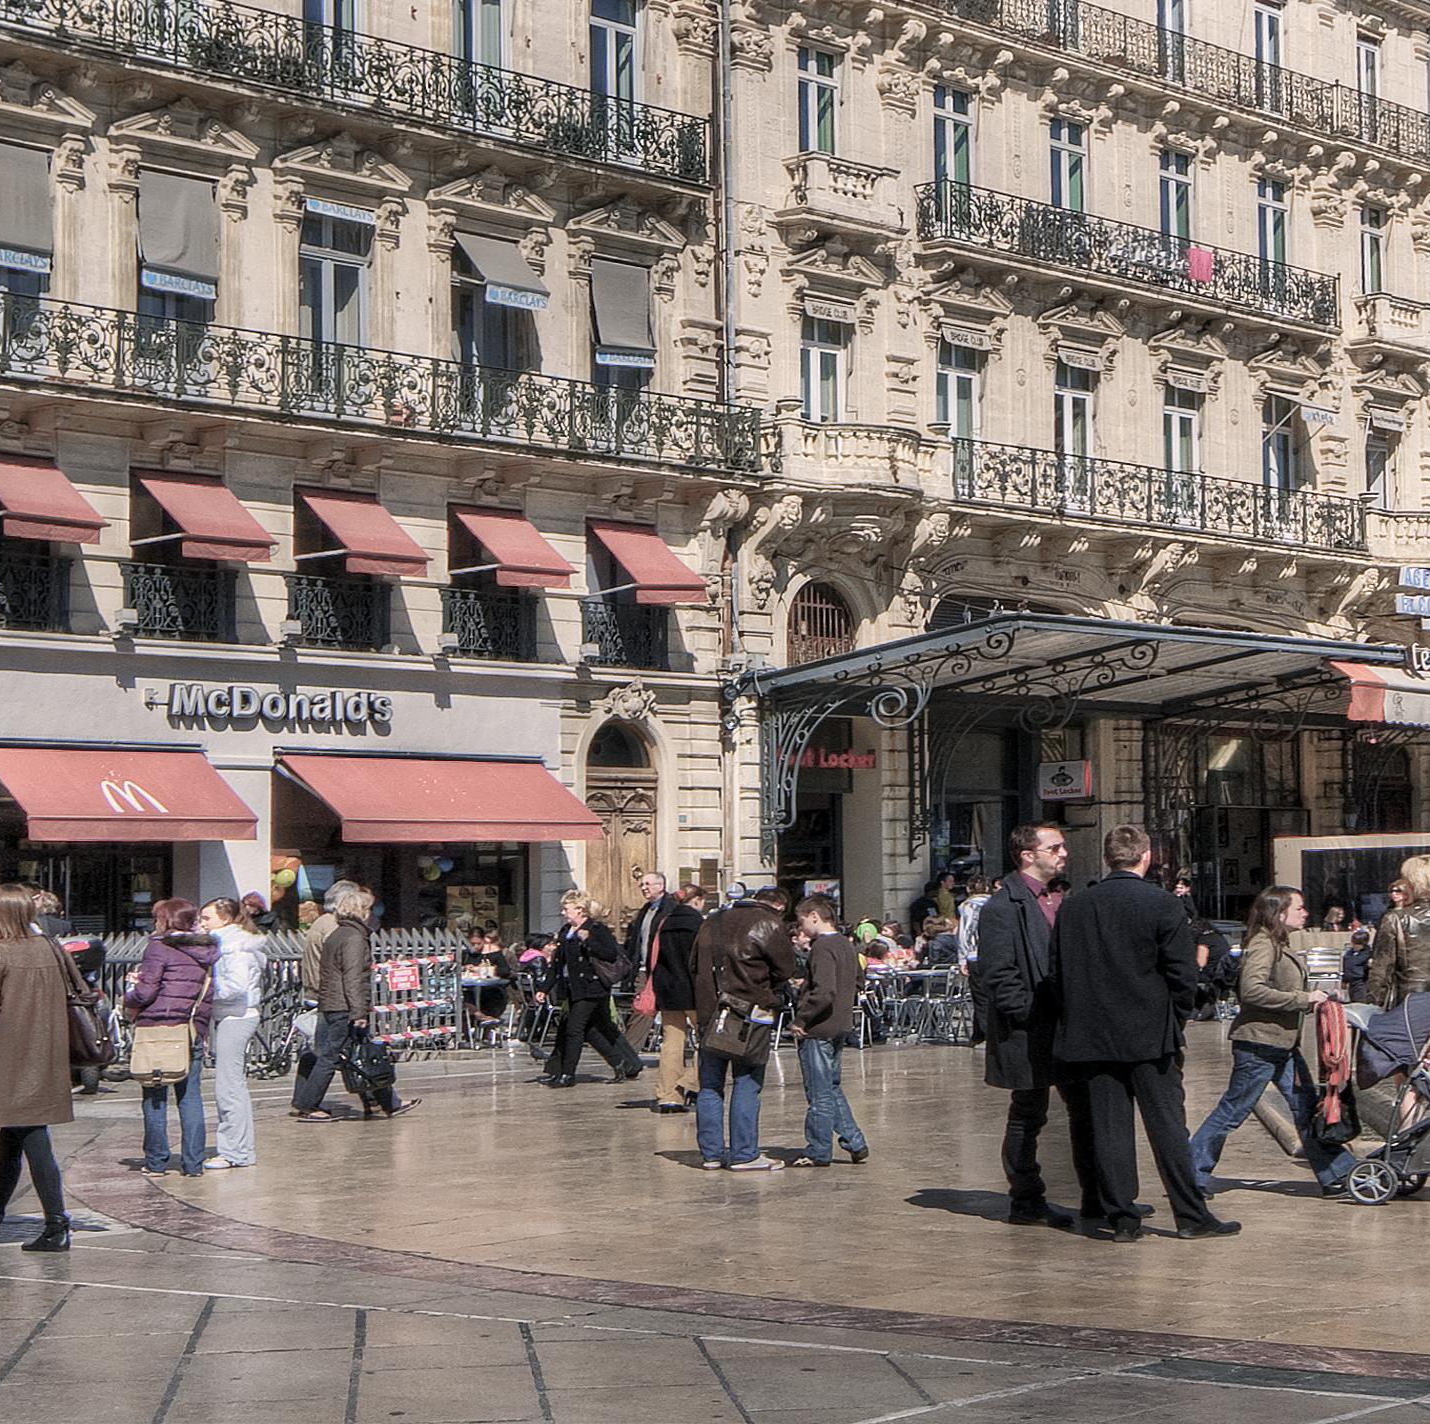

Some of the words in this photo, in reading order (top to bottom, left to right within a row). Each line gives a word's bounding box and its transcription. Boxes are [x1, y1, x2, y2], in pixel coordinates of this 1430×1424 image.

[322, 201, 375, 223] BARCLAYS
[159, 274, 214, 296] BARCLAYS
[500, 289, 548, 309] BARCLAYS
[169, 682, 394, 725] McDonald's
[818, 747, 877, 769] Locker
